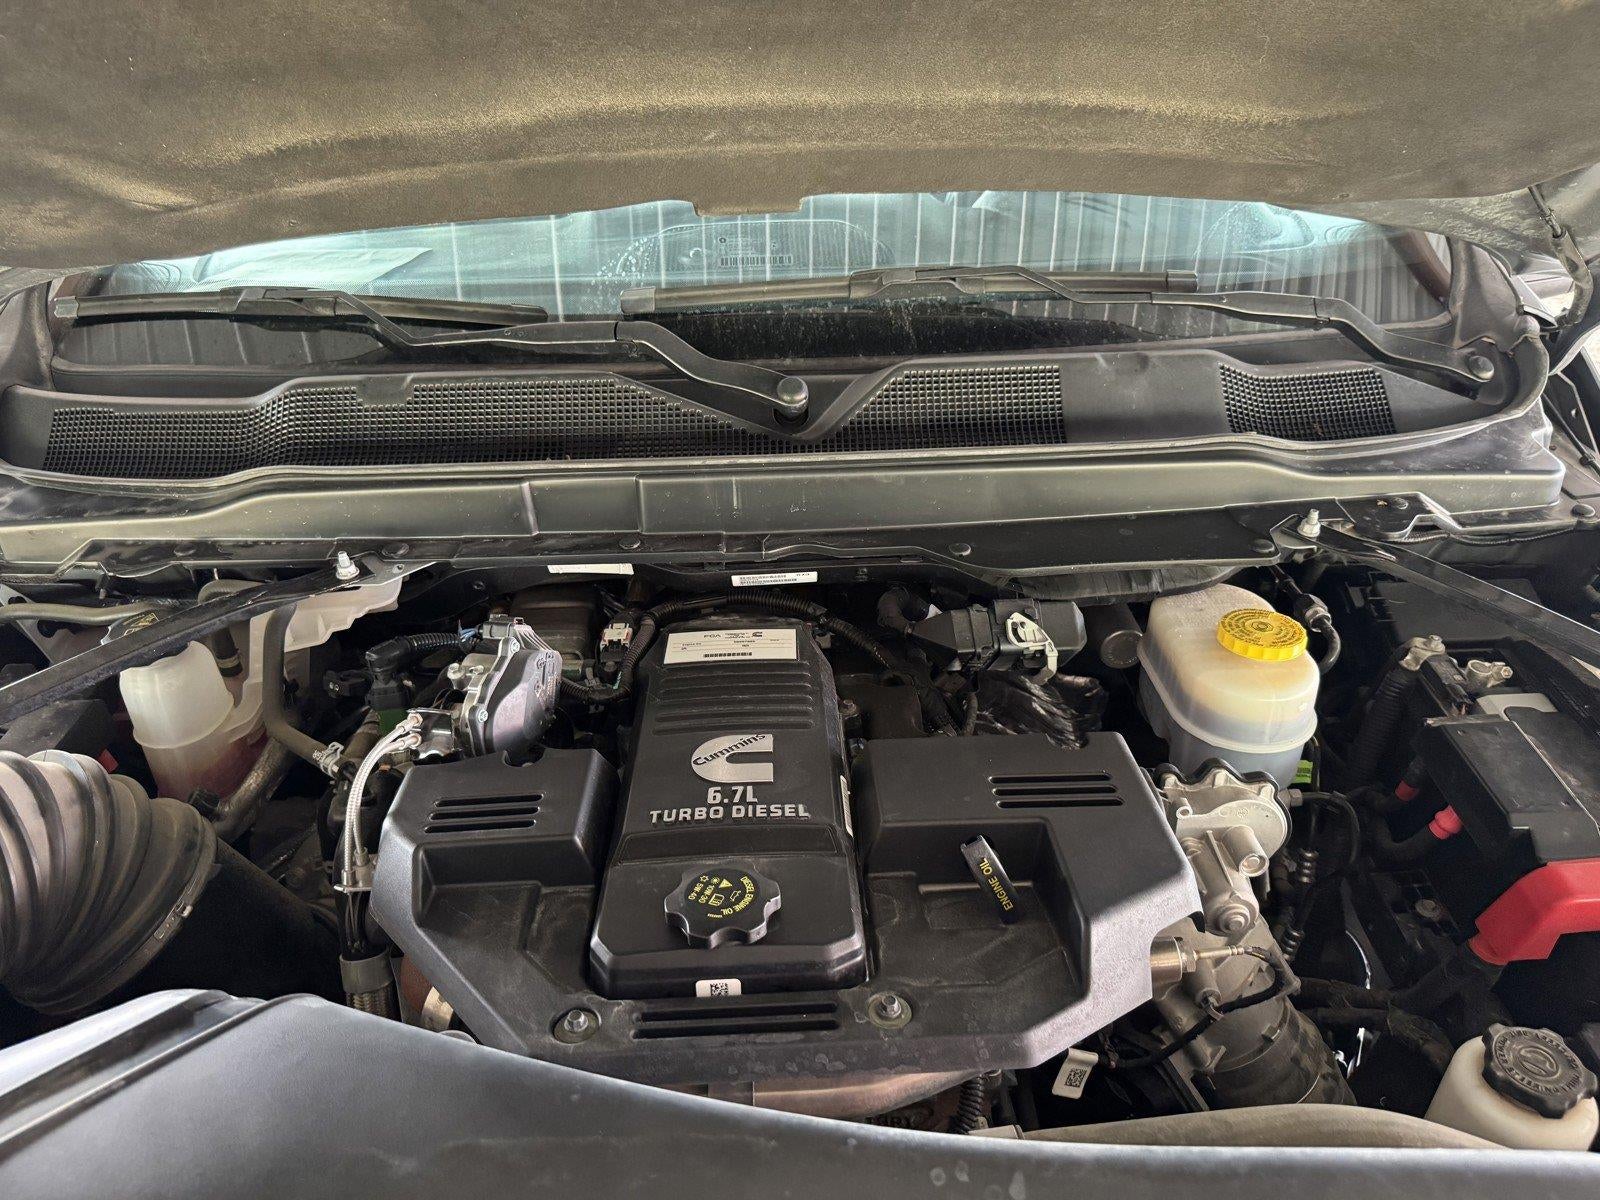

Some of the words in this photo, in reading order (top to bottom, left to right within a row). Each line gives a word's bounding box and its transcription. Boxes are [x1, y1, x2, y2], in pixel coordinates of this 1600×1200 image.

[692, 733, 766, 766] Cummins
[707, 785, 758, 804] 6.7L
[650, 806, 724, 824] TURBO
[732, 803, 811, 820] DIESEL
[979, 858, 992, 875] OIL
[740, 876, 755, 893] DIESEL
[988, 875, 1013, 911] ENGINE
[734, 893, 754, 911] ENGINE
